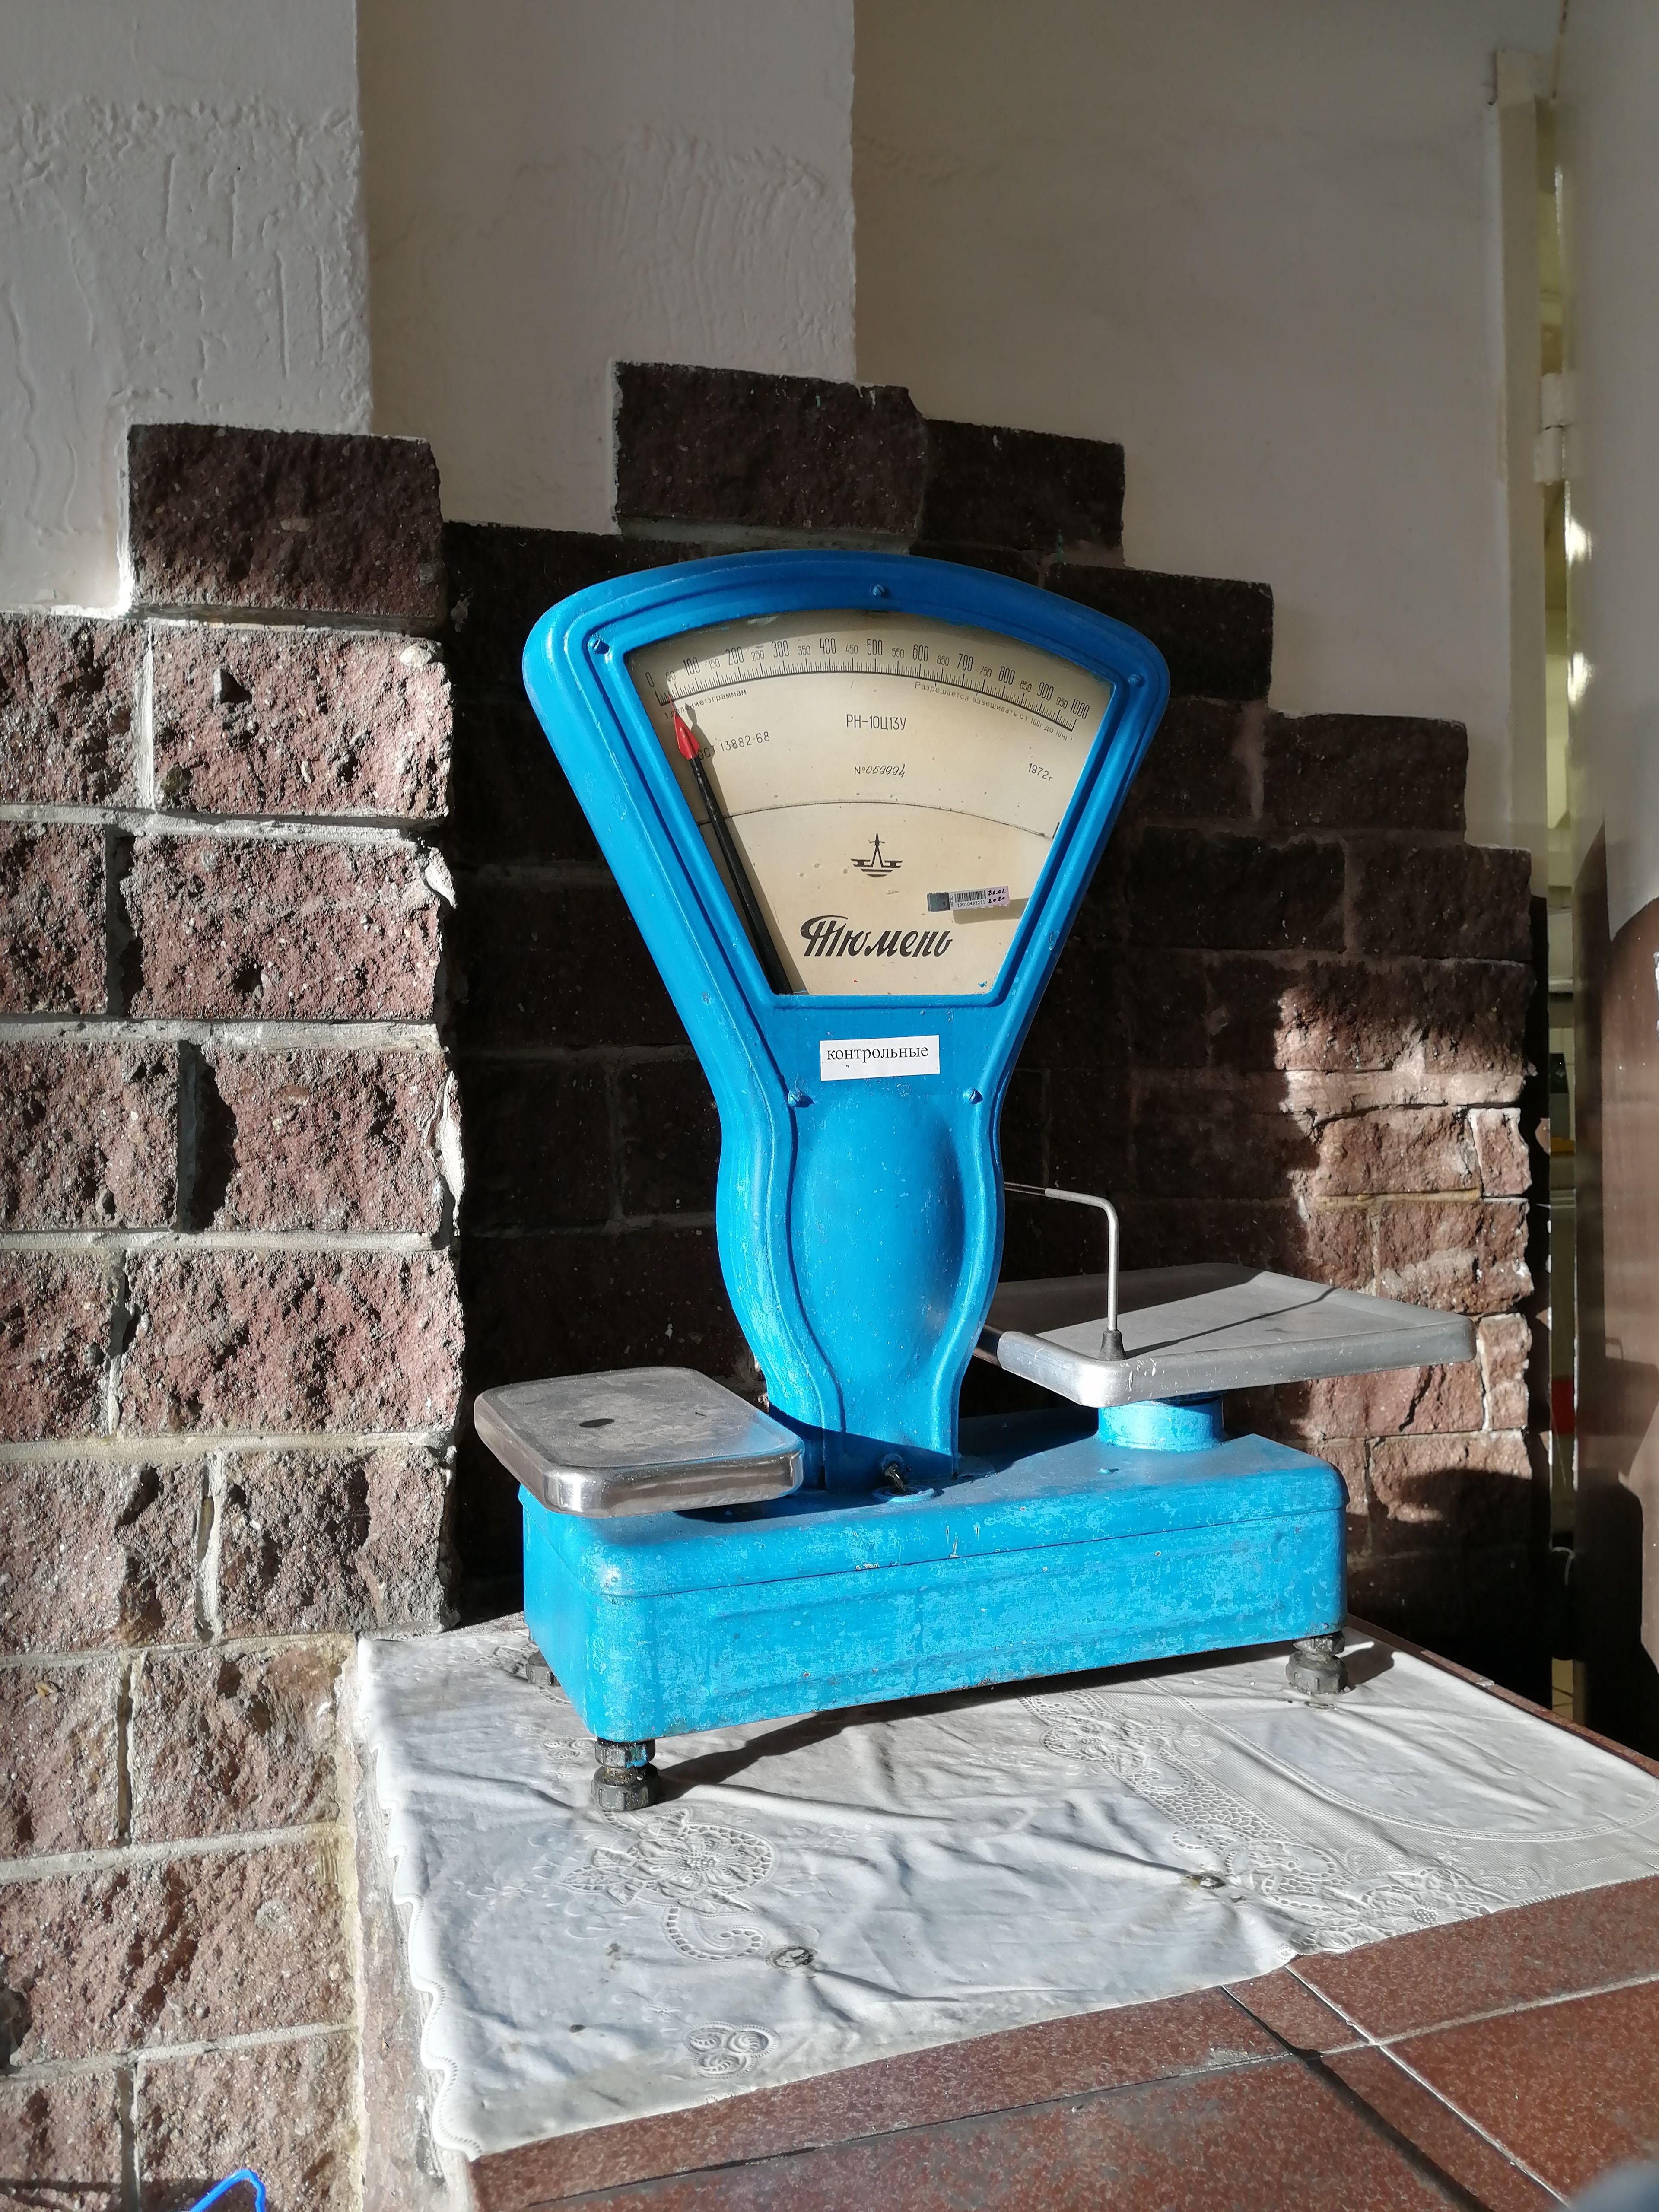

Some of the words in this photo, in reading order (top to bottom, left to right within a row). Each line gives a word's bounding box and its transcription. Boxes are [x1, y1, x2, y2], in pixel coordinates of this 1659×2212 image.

[645, 672, 655, 688] 0
[665, 671, 676, 682] 50
[683, 657, 700, 676] 100
[708, 658, 720, 670] 150
[725, 646, 744, 665] 200
[751, 650, 765, 661] 250
[771, 640, 789, 658] 300
[798, 645, 811, 655] 350
[820, 638, 836, 655] 400
[845, 645, 858, 655] 450
[867, 639, 883, 656] 500
[892, 648, 905, 658] 550
[912, 644, 929, 662] 600
[937, 655, 950, 666] 650
[957, 653, 973, 672] 700
[979, 666, 992, 678] 750
[998, 666, 1015, 685] 800
[1020, 680, 1032, 692] 850
[1037, 682, 1054, 701] 900
[1055, 697, 1068, 709] 950
[1070, 698, 1090, 719] 1000
[915, 681, 969, 701] Разрешается
[972, 696, 1017, 717] взвешивать
[846, 714, 906, 730] РН-10Ц13У
[720, 731, 770, 752] 13882-68
[1028, 763, 1053, 782] 1972г
[800, 915, 953, 957] Тюмень
[826, 1047, 928, 1063] контрольные
